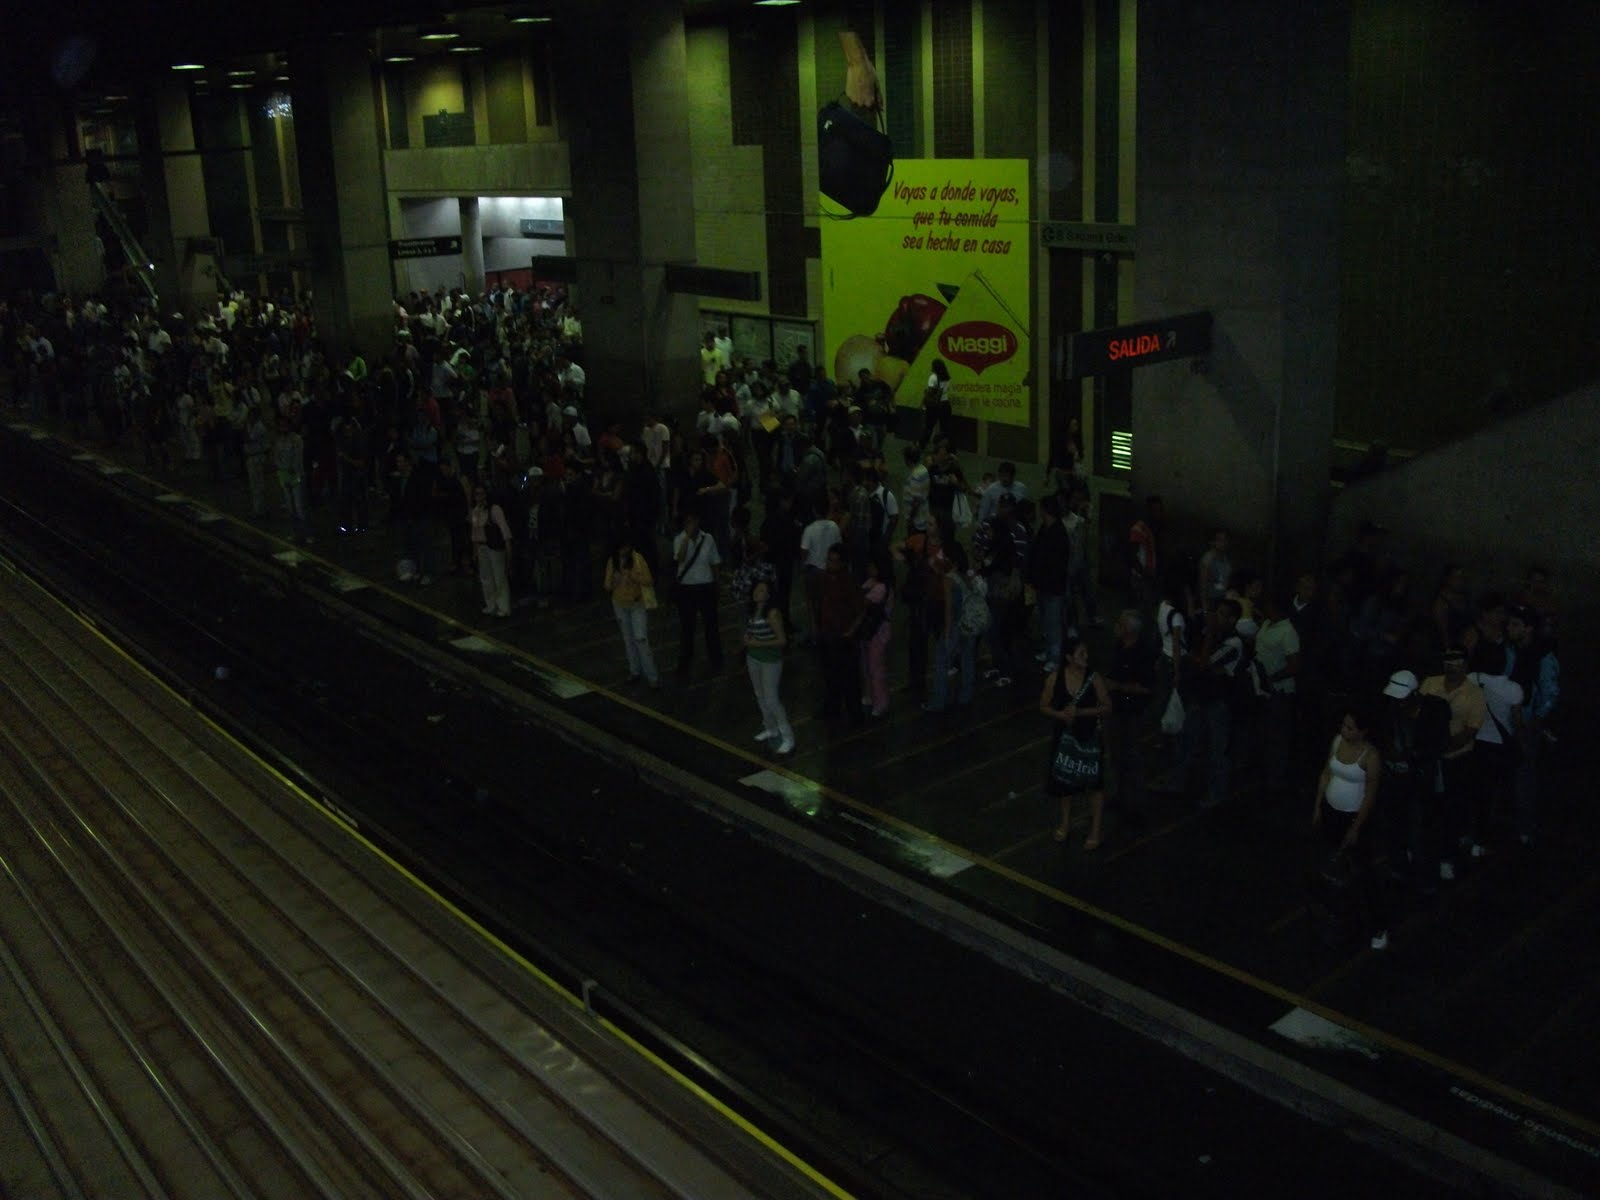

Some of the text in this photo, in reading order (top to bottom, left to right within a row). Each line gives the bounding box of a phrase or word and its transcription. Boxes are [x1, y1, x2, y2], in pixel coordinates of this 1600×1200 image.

[893, 179, 1019, 206] Vayas a donde vayas,
[913, 206, 998, 230] que tu comida
[902, 230, 1012, 255] sea hecha en casa
[946, 335, 1008, 355] Maggi
[1107, 332, 1161, 361] SALIDA
[993, 382, 1022, 395] magia
